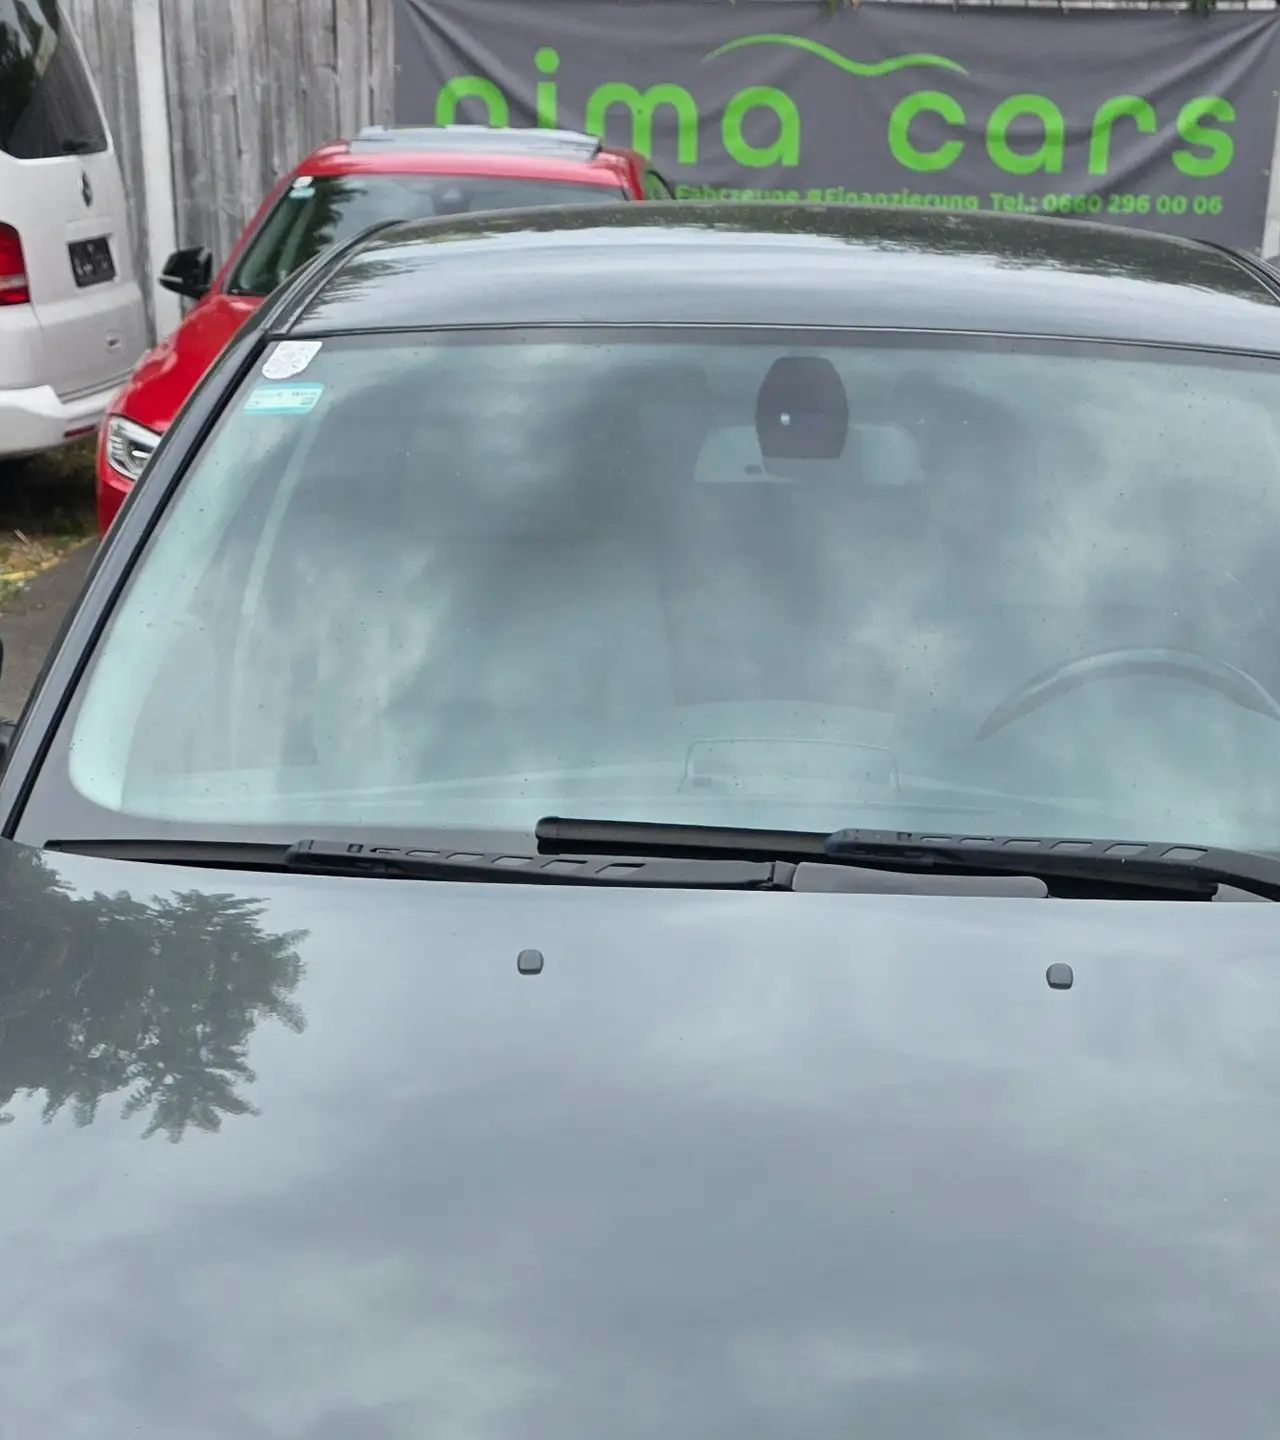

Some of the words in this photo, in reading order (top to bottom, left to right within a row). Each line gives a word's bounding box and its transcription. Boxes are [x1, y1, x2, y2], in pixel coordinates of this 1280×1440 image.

[435, 47, 801, 167] nima
[887, 89, 1237, 178] cars
[1156, 194, 1187, 214] 00
[1192, 194, 1223, 214] 06
